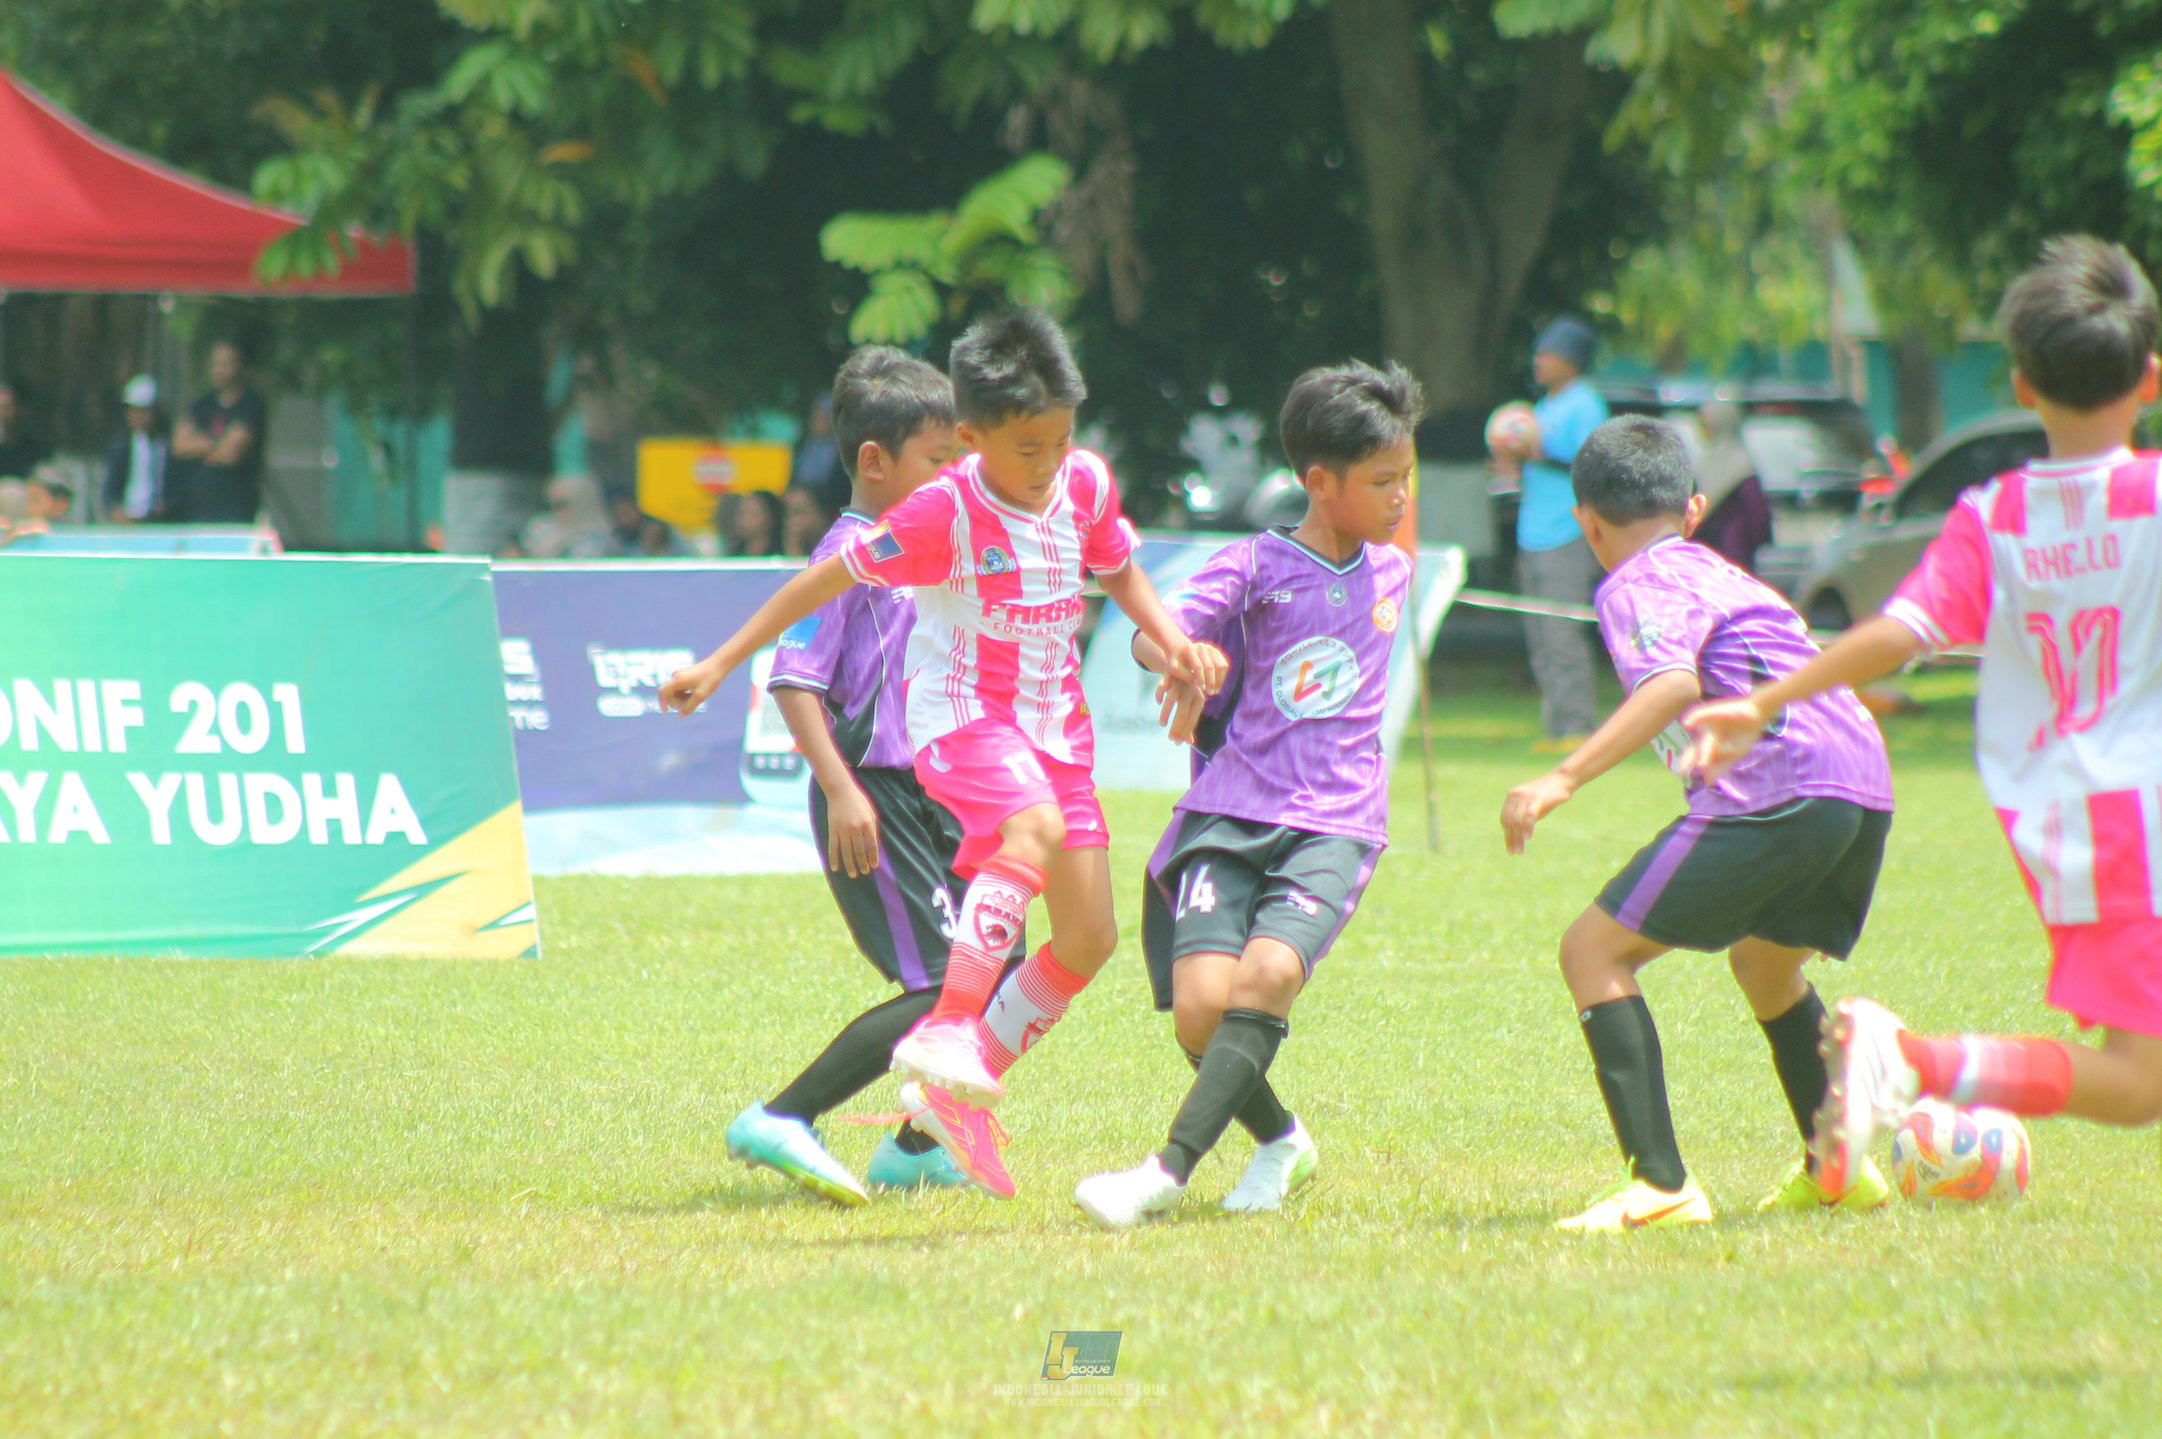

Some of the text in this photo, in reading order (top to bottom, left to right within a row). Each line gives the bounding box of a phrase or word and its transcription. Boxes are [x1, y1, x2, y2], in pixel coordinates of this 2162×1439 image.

[0, 678, 306, 754] NIF 201
[0, 771, 429, 845] YA YUDHA
